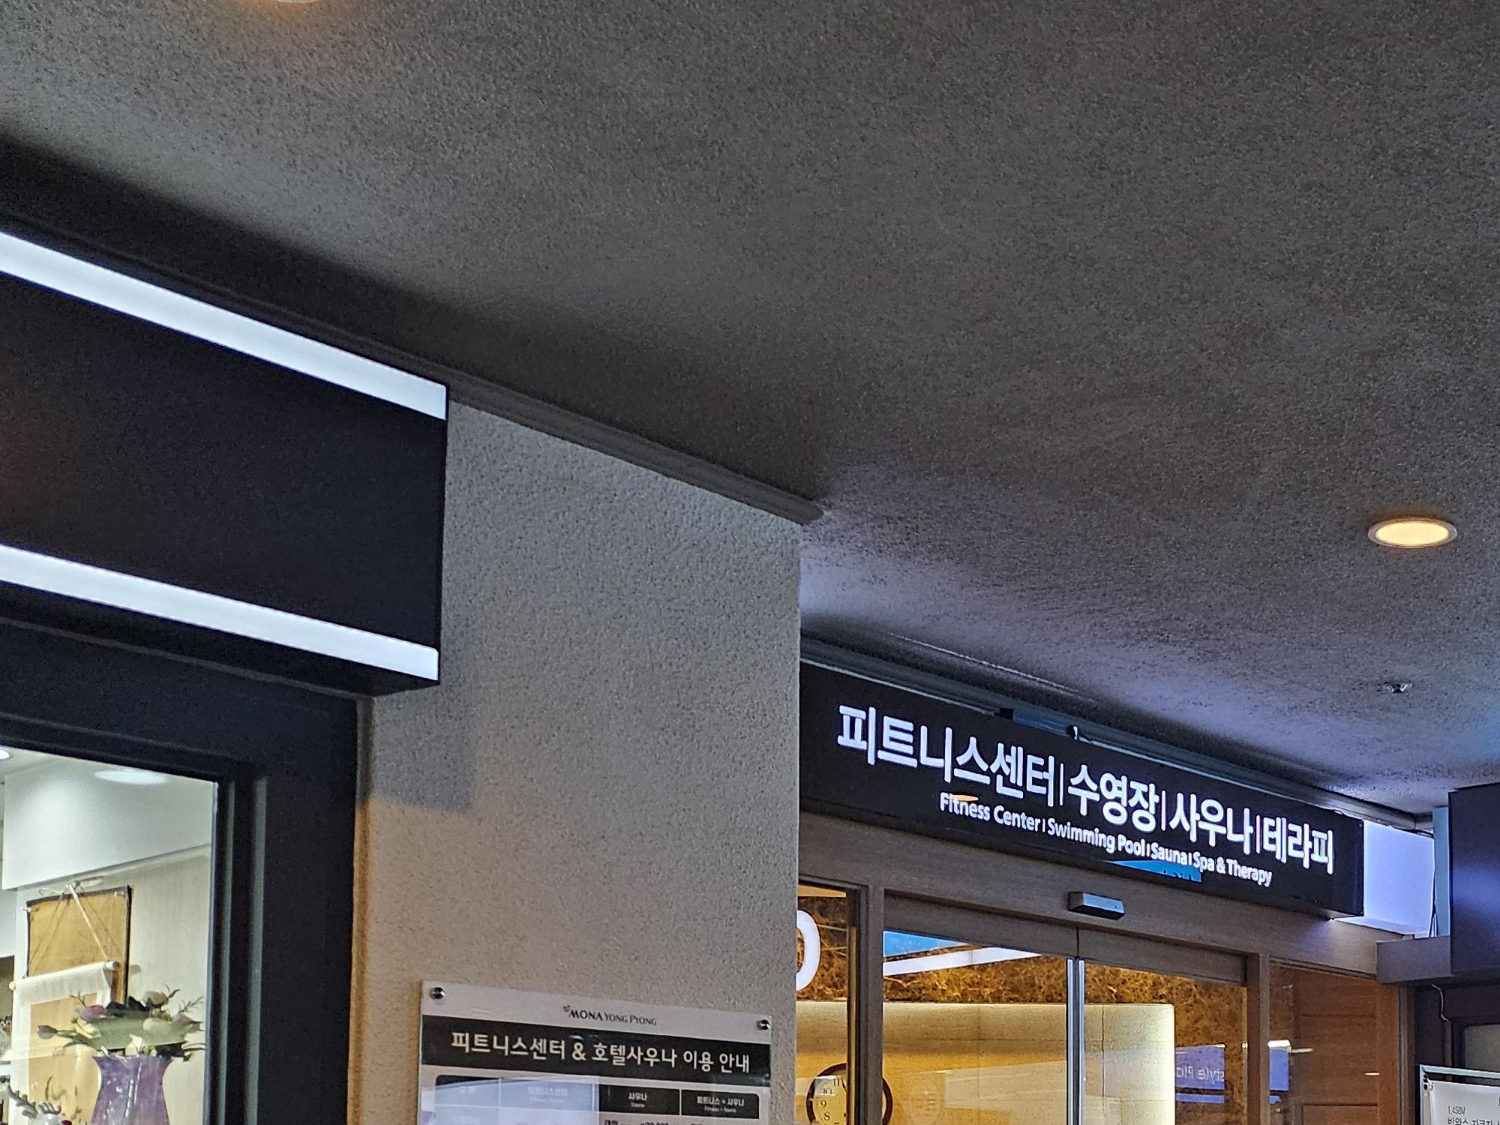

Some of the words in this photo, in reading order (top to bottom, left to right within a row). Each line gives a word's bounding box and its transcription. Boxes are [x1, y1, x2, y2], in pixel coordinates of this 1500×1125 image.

[837, 704, 1055, 808] 피트니스센터
[1067, 764, 1159, 833] 수영장
[1168, 791, 1254, 856] 사우나
[1262, 815, 1334, 875] 테라피
[939, 792, 991, 822] Fitness
[993, 806, 1042, 833] Center
[1047, 817, 1116, 854] Swimming
[1117, 834, 1146, 857] Pool
[1151, 842, 1187, 867] Sauna
[1193, 851, 1215, 873] Spa
[1216, 856, 1226, 875] &
[1226, 858, 1273, 888] Therapy
[568, 1009, 602, 1021] MONA
[603, 1011, 628, 1023] YONG
[629, 1014, 657, 1026] PYONG
[450, 1030, 566, 1061] 피트니스센터
[571, 1042, 587, 1062] &
[591, 1041, 677, 1068] 호텔사우나
[682, 1050, 714, 1073] 이용
[718, 1053, 750, 1074] 안내
[820, 1100, 827, 1108] 9
[823, 1112, 831, 1121] 8
